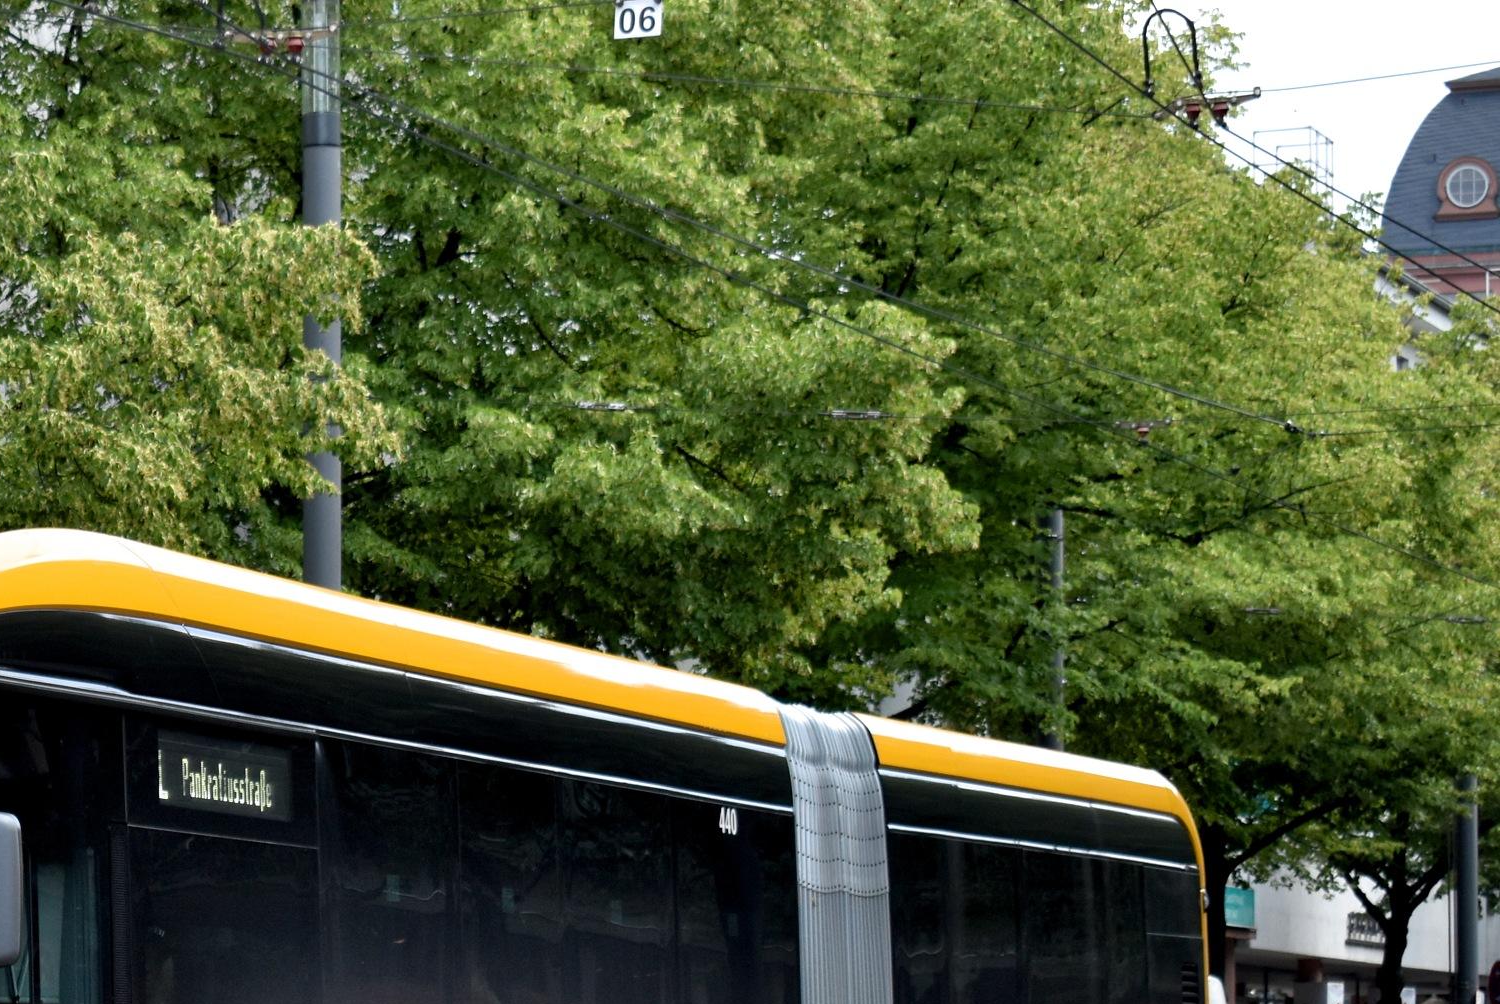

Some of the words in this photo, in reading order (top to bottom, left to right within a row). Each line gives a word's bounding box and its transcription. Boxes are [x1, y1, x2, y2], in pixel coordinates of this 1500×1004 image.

[619, 6, 656, 34] 06
[158, 749, 169, 799] L
[182, 758, 272, 812] Pankratiusstraße
[719, 807, 738, 835] 440
